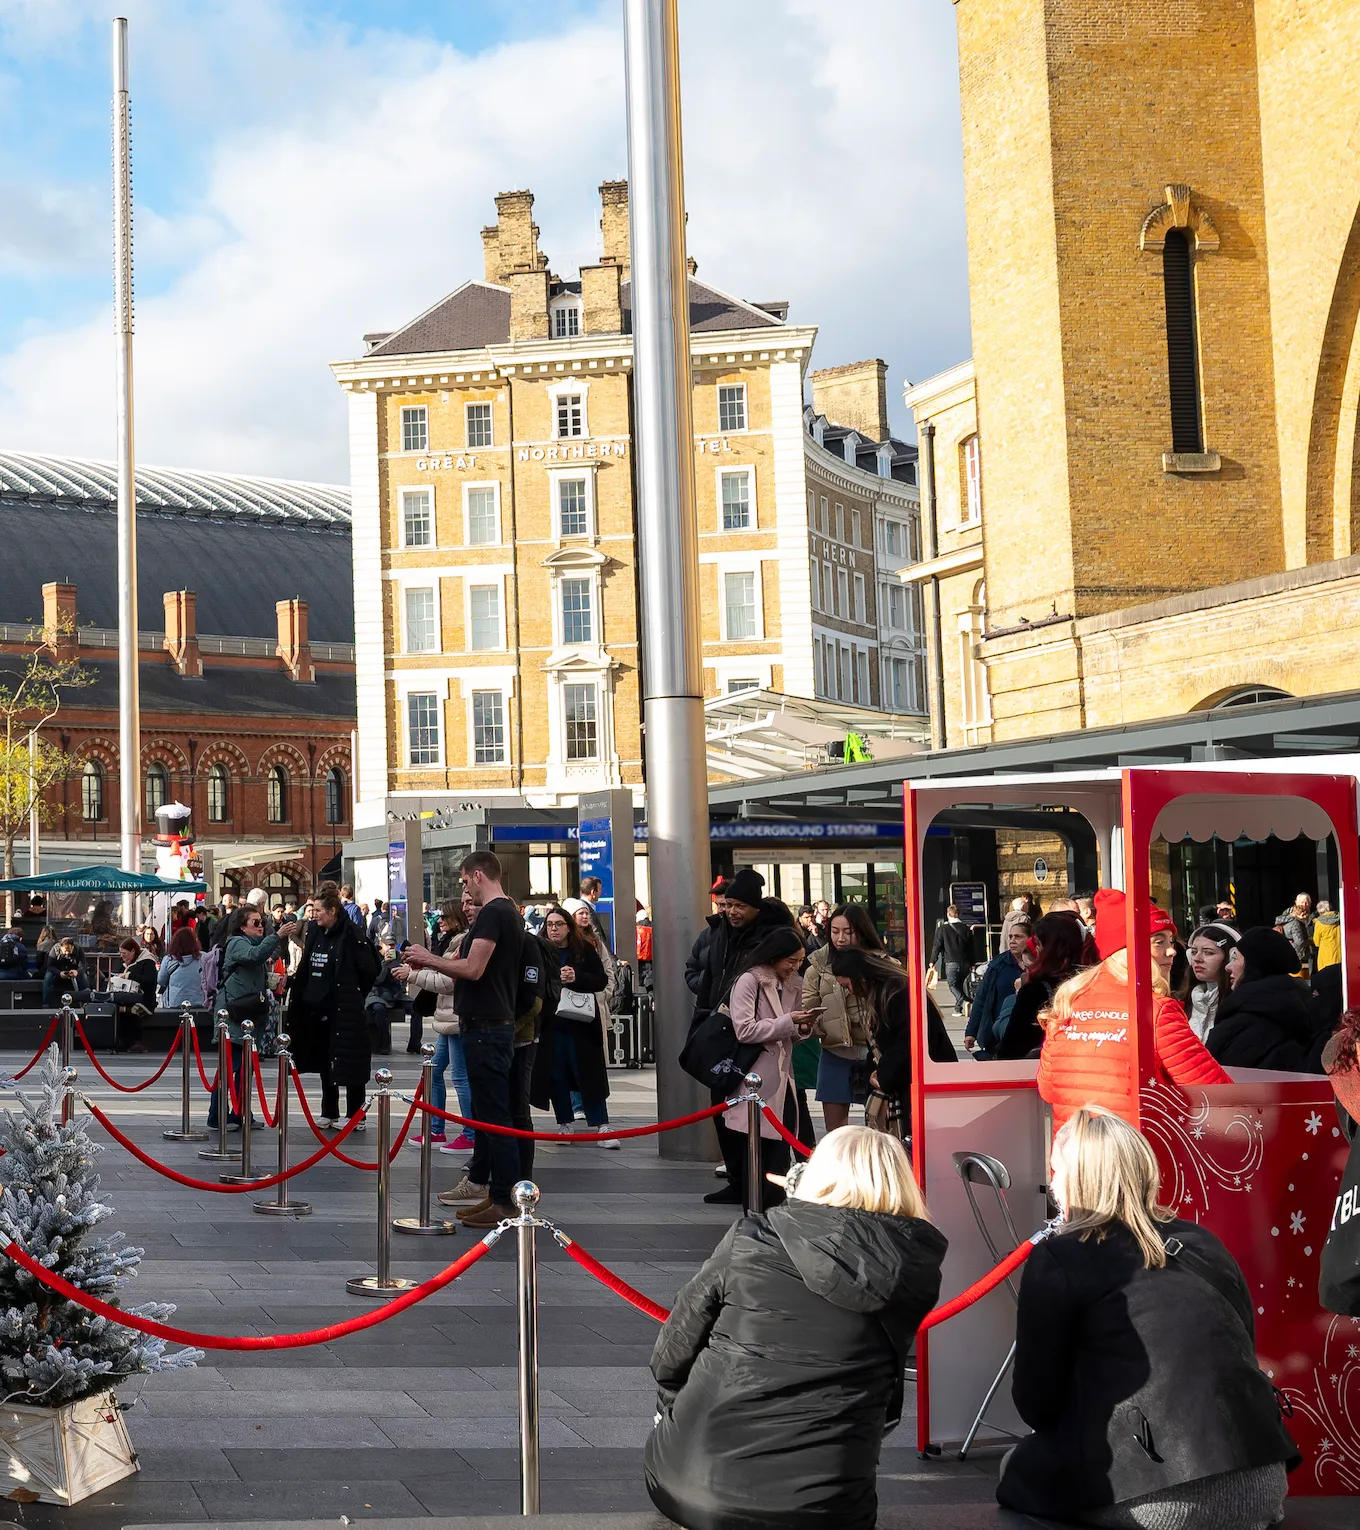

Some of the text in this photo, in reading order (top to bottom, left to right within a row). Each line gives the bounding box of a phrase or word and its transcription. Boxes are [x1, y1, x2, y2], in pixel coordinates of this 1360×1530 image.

[416, 439, 732, 471] GREAT NORTHERN TEL
[730, 825, 824, 837] UNDERGROUND
[828, 824, 877, 836] STATION
[107, 880, 144, 889] MARKET
